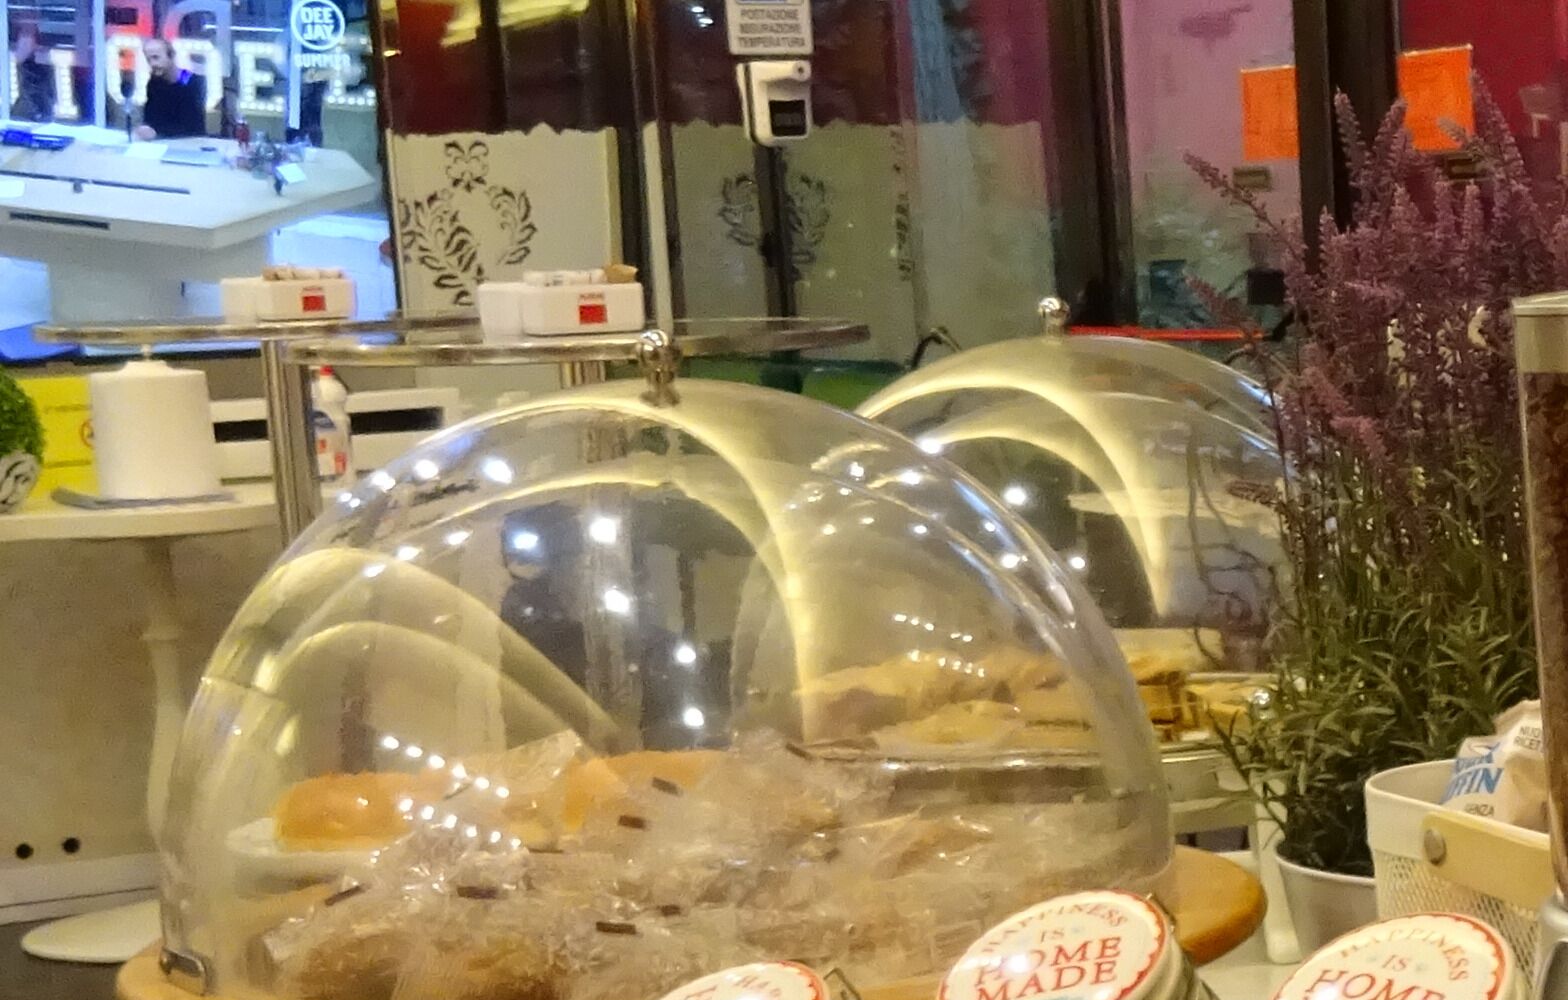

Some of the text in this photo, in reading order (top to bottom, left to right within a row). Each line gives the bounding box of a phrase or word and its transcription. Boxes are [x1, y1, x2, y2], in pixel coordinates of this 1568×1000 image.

[300, 7, 335, 24] DEE
[302, 24, 335, 41] JAY
[1040, 927, 1066, 944] IS
[973, 936, 1122, 989] HOME
[1339, 927, 1470, 983] HAPPINESS
[1381, 953, 1411, 972] IS
